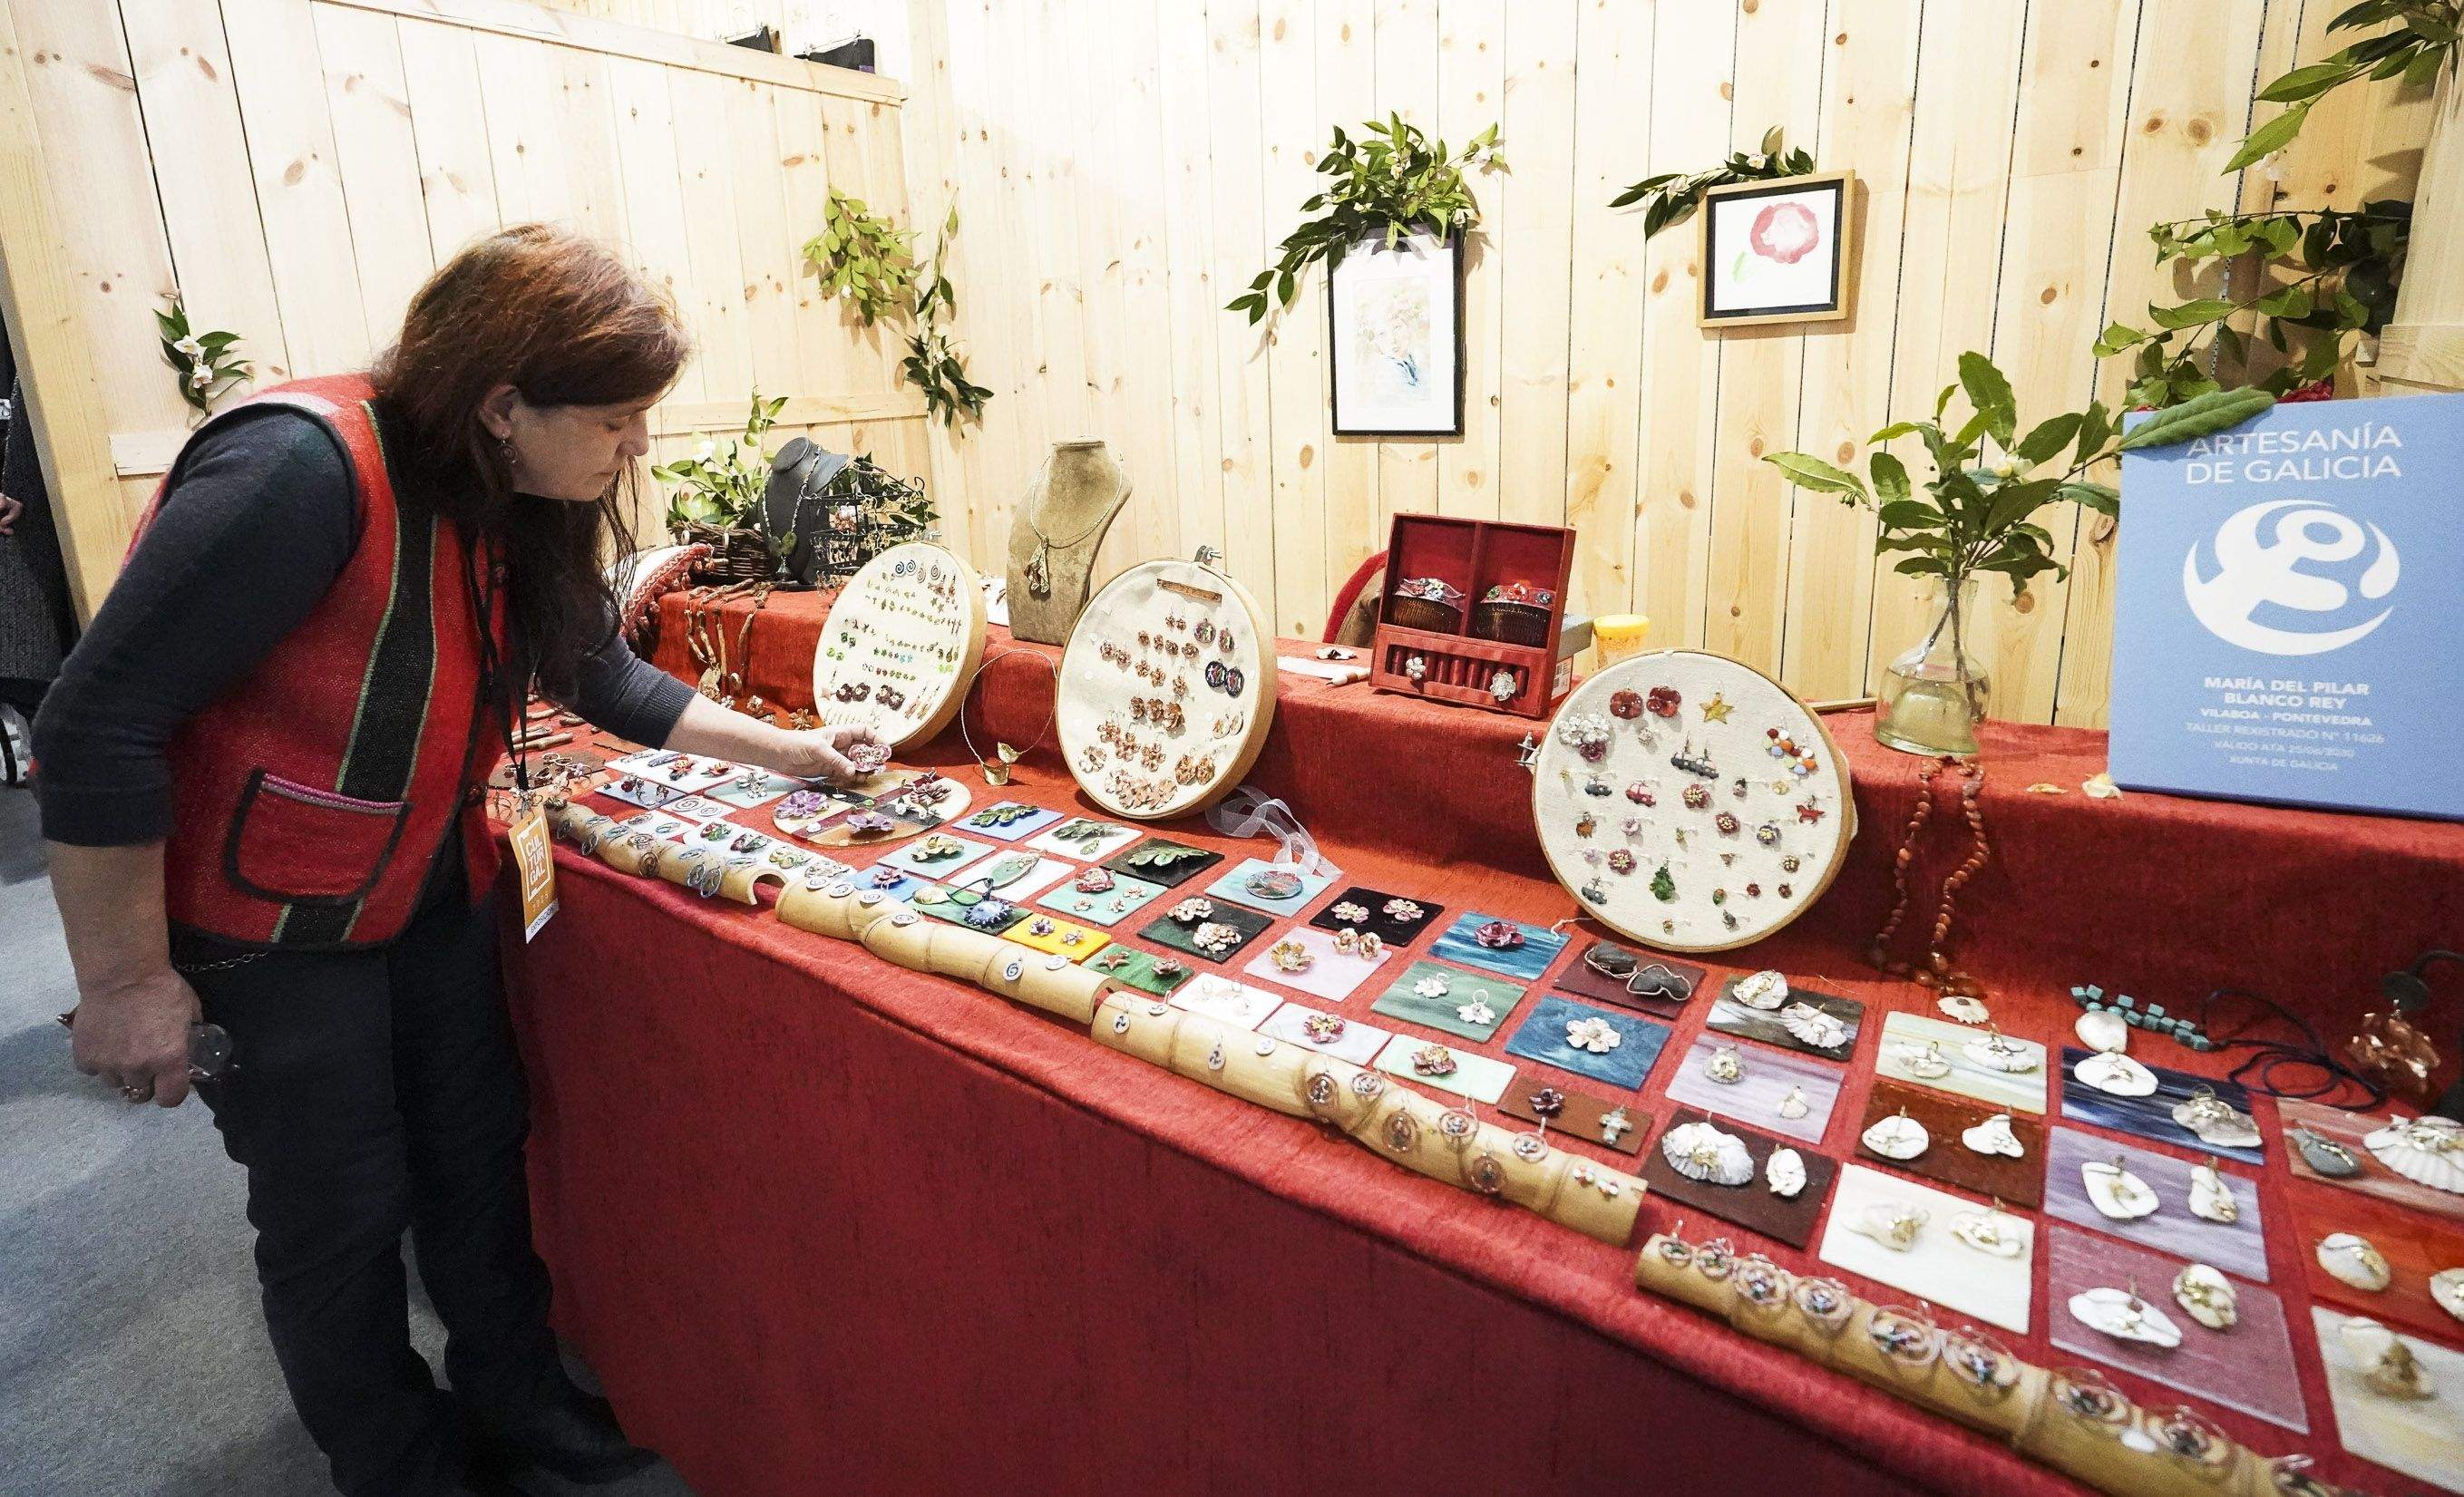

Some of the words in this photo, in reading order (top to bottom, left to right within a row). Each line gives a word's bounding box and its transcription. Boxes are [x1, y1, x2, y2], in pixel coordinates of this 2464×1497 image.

[2186, 422, 2403, 457] ARTESANÍA
[2186, 461, 2234, 485] DE
[2244, 455, 2402, 483] GALICIA
[2204, 676, 2265, 691] MARÍA
[2271, 680, 2306, 693] DEL
[2313, 682, 2371, 696] PILAR
[2225, 692, 2303, 707] BLANCO
[2310, 695, 2347, 710] REY
[2273, 712, 2372, 726] PONTEVEDRA
[526, 833, 543, 857] CUL
[528, 845, 545, 871] TUR
[530, 860, 546, 886] GAL
